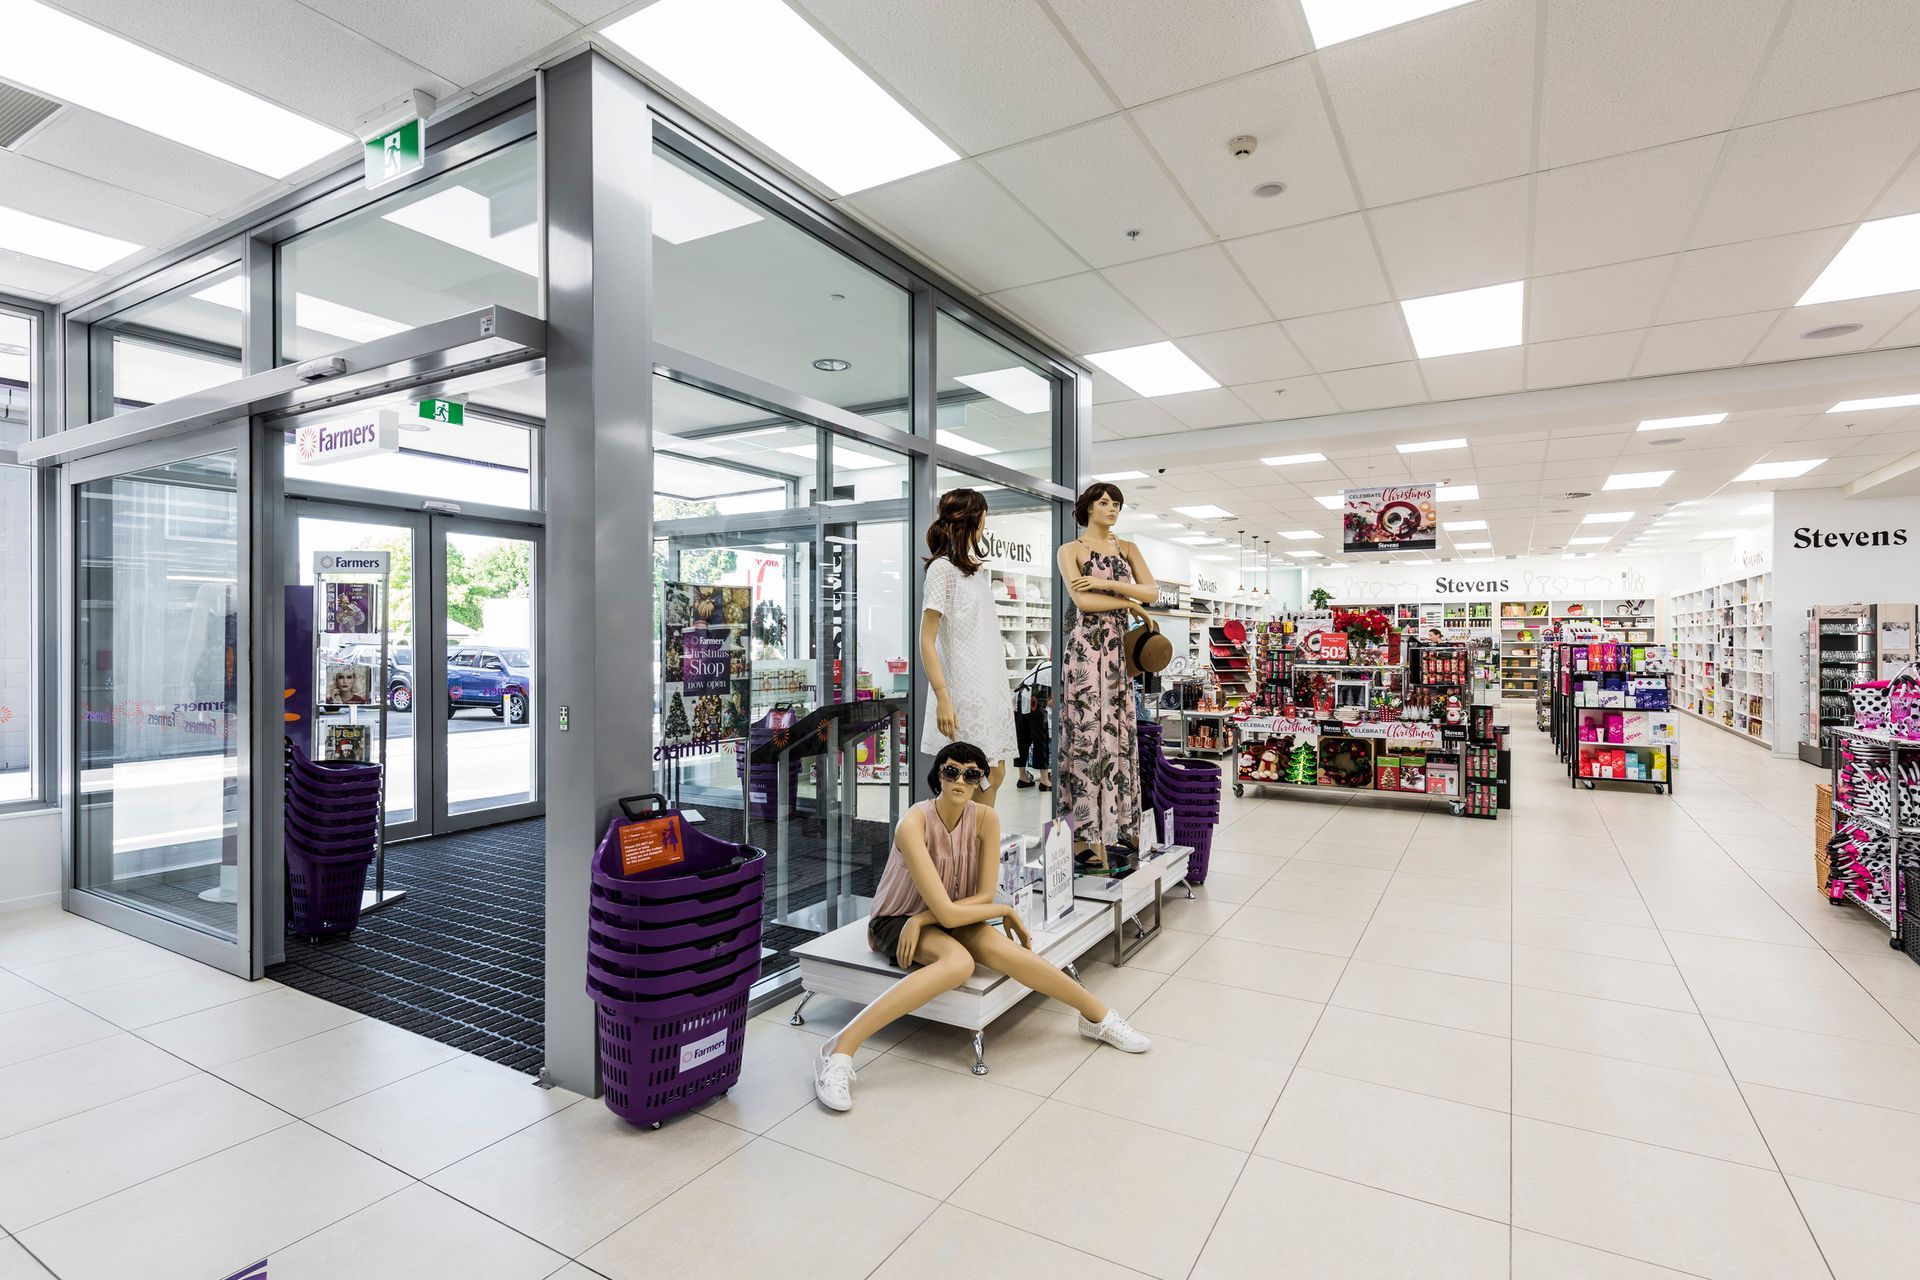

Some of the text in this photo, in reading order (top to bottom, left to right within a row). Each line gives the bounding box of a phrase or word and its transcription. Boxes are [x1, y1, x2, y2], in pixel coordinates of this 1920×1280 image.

[319, 424, 375, 453] Farmers
[1382, 487, 1431, 502] Christmas
[1793, 527, 1908, 549] Stevens
[978, 530, 1032, 563] Stevens
[335, 556, 380, 568] Farmers
[1435, 576, 1509, 594] Stevens
[699, 637, 725, 645] Farmers
[685, 648, 730, 659] Christmas
[690, 660, 725, 677] Shop
[688, 680, 727, 690] now open
[1272, 719, 1316, 733] Christmas
[1386, 724, 1435, 739] Christmas
[694, 1038, 726, 1059] Farmers
